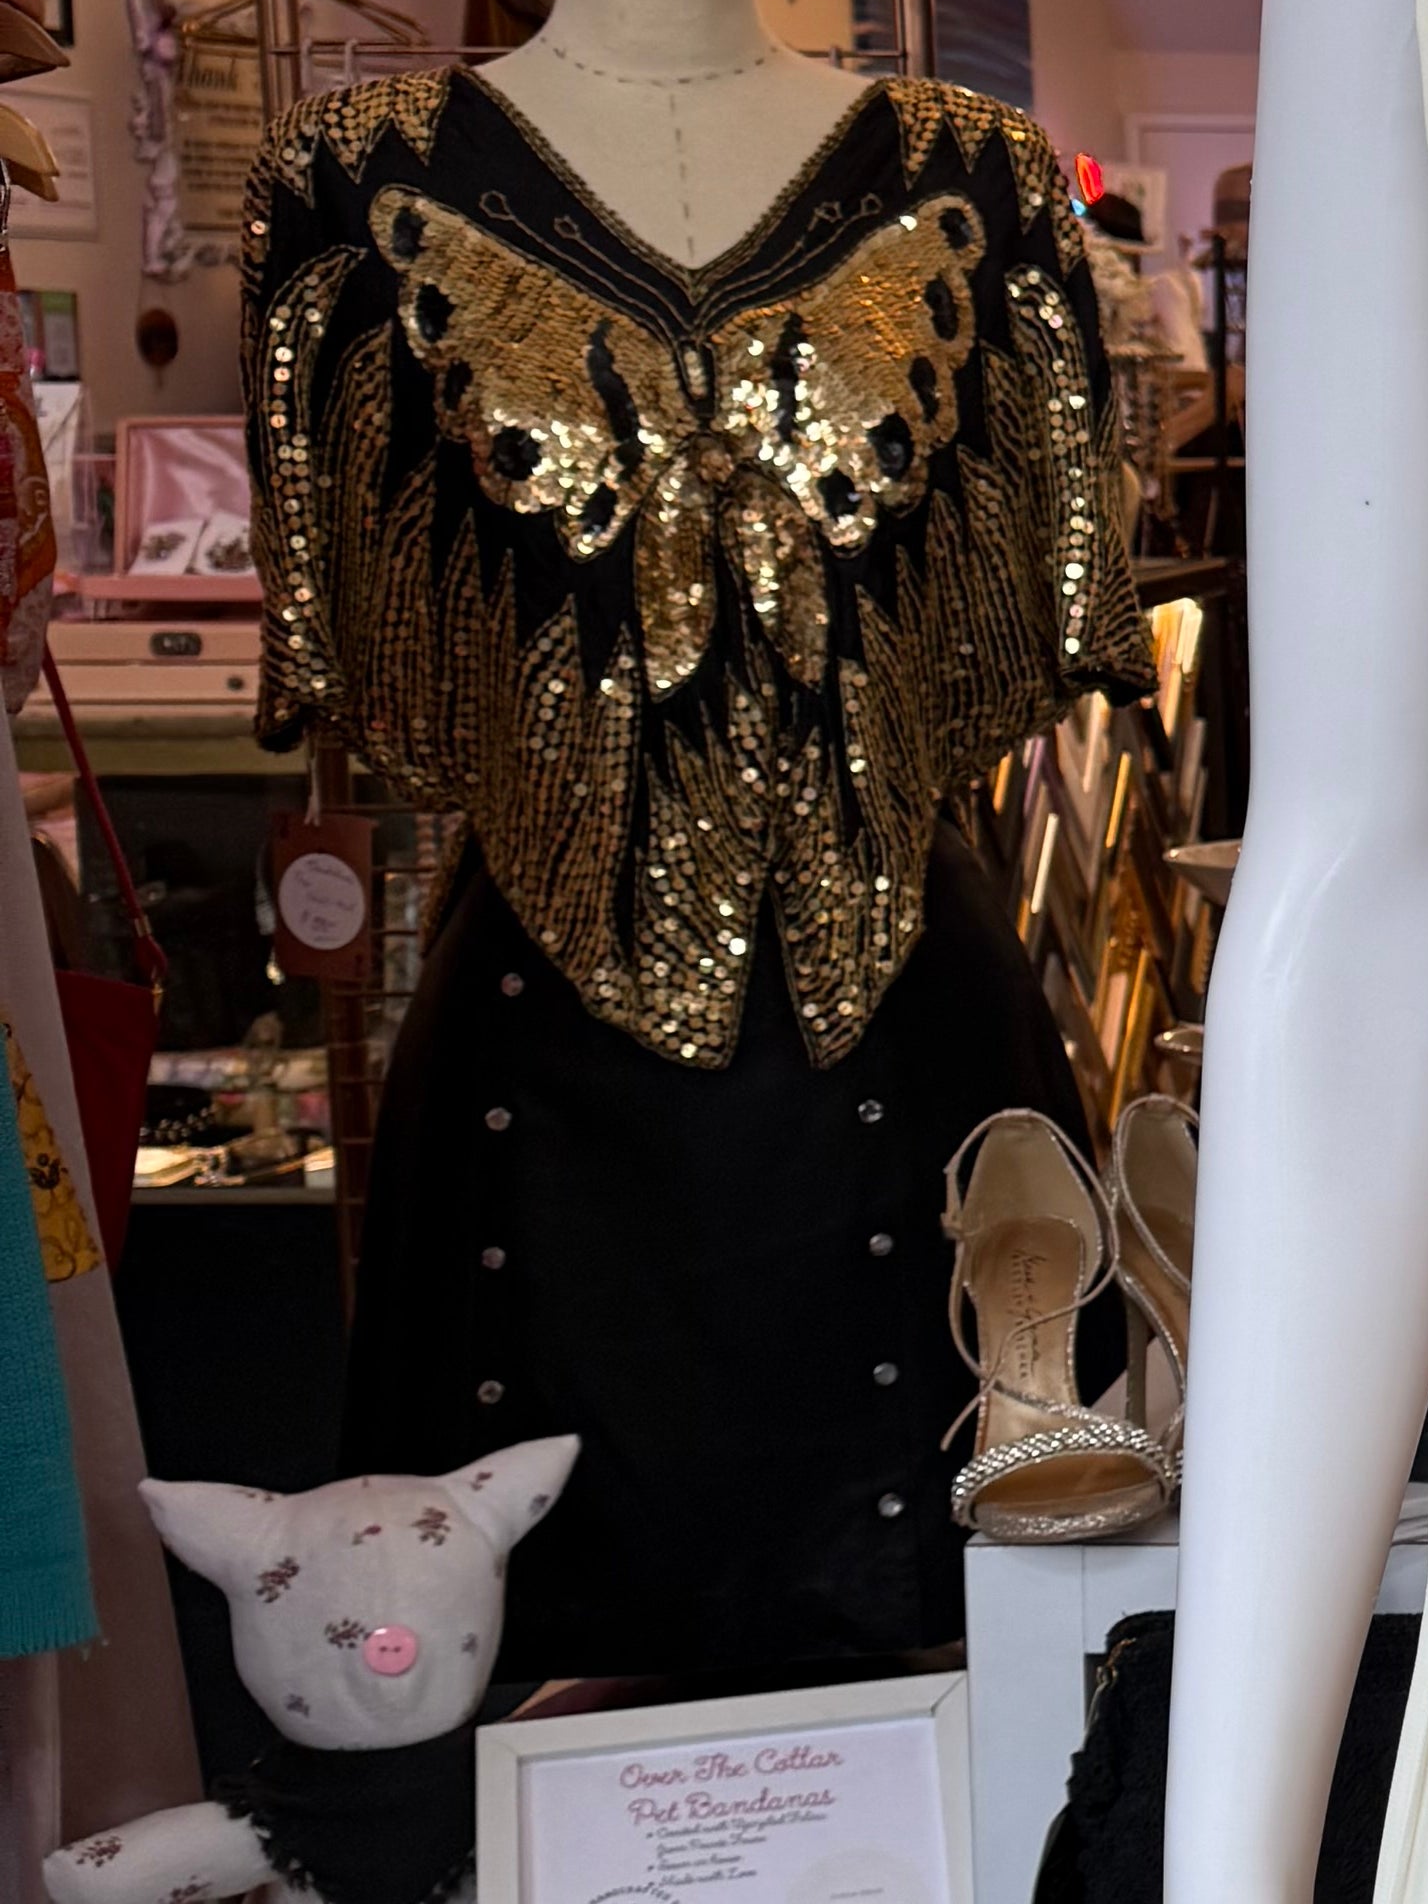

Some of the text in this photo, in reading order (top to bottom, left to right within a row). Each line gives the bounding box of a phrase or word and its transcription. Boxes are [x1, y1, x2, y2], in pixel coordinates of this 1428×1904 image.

[619, 1745, 845, 1789] Over The Collar
[627, 1787, 836, 1827] Pet Bandanas
